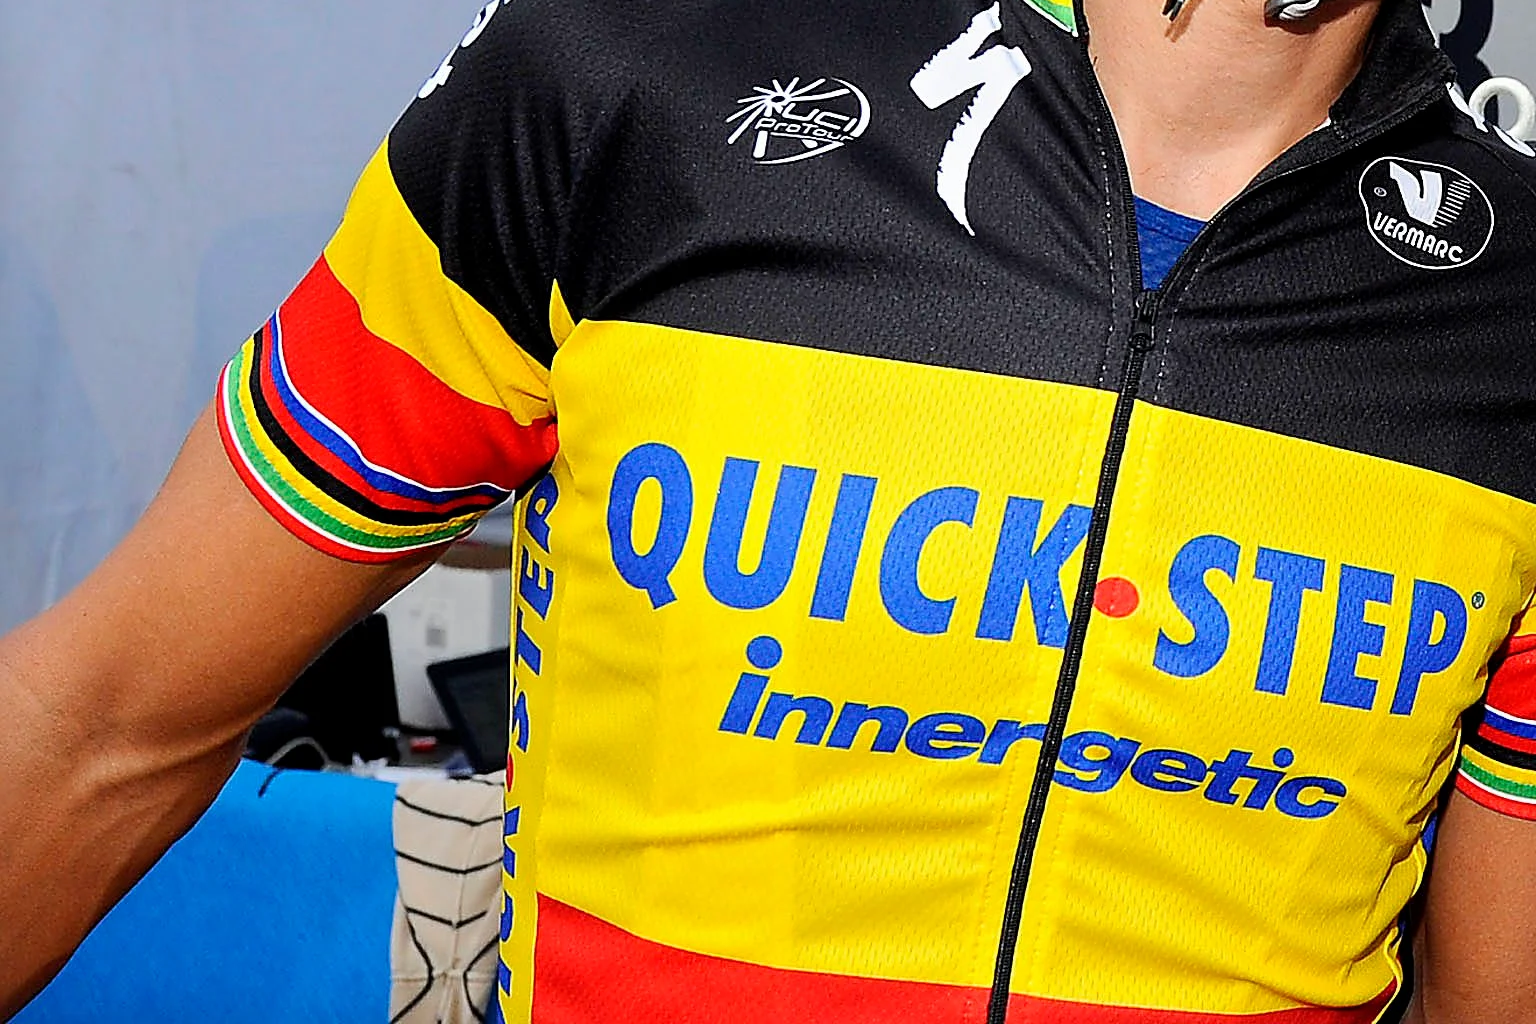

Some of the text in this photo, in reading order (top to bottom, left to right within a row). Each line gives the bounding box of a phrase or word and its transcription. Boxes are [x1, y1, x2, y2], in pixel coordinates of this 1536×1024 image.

[755, 117, 853, 141] ProTour
[782, 102, 857, 132] UCI
[1373, 211, 1464, 263] VERMARC
[719, 636, 1346, 819] innergetic
